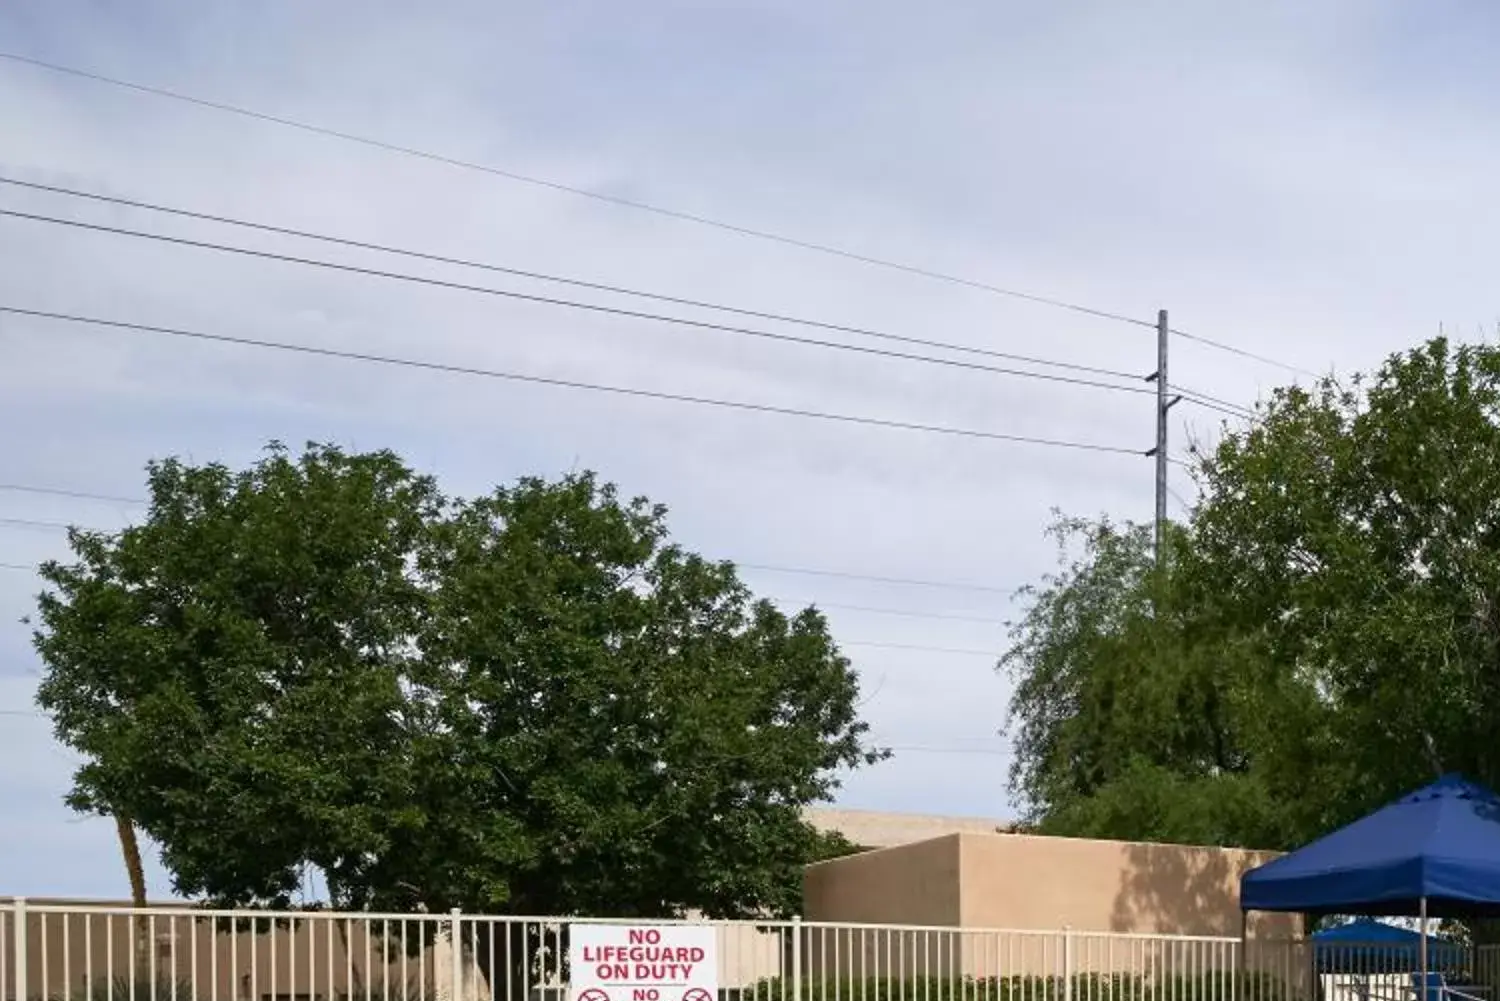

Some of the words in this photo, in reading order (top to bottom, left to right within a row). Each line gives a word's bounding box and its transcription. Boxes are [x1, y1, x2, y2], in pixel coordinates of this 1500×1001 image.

[629, 929, 661, 945] NO
[583, 947, 705, 962] LIFEGUARD
[596, 964, 629, 980] ON
[635, 964, 693, 980] DUTY
[633, 989, 660, 1001] NO
